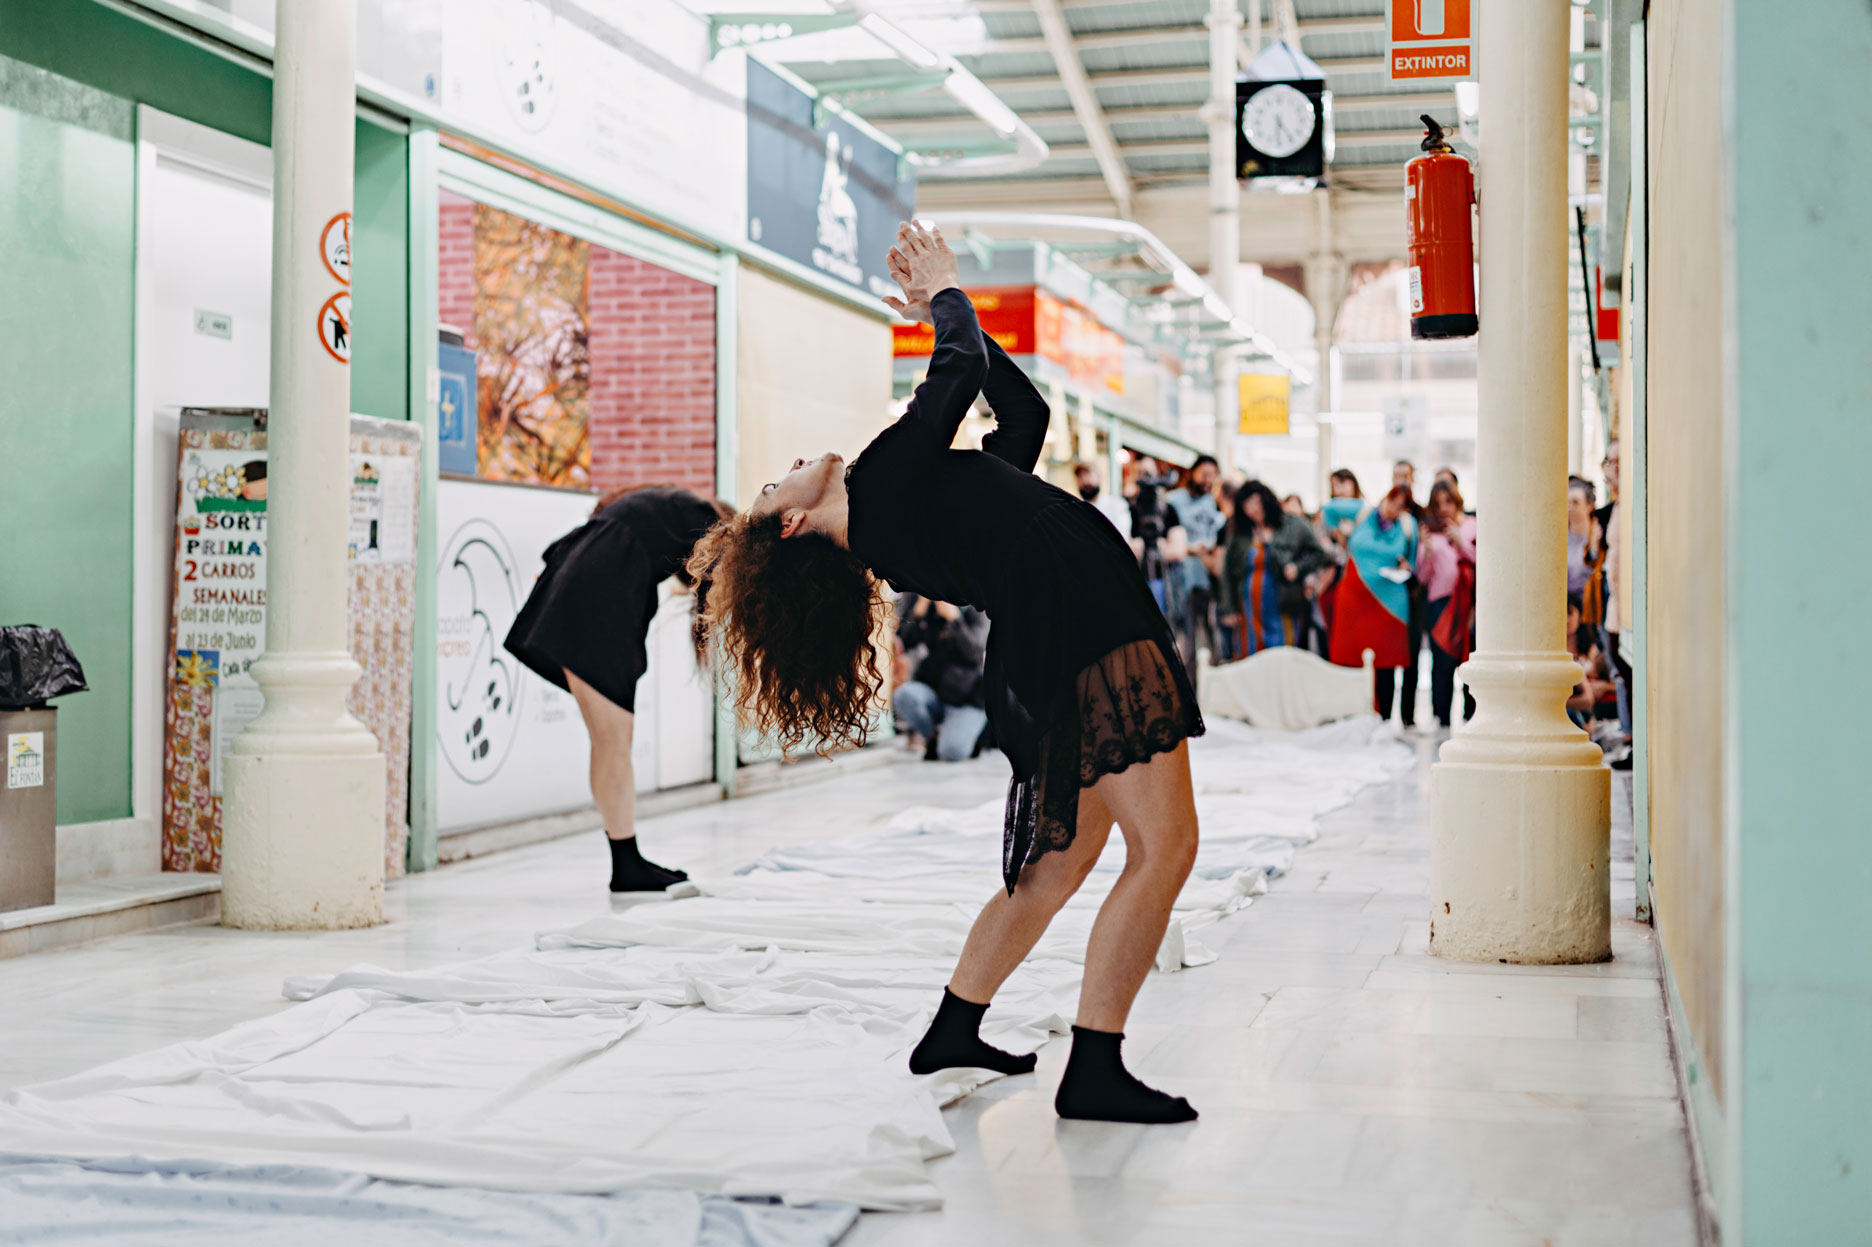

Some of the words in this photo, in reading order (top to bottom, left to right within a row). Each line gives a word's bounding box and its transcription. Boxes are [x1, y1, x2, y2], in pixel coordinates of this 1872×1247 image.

[1395, 55, 1466, 70] EXTINTOR
[187, 540, 267, 556] PRIMA
[183, 560, 198, 581] 2
[201, 561, 256, 579] CARROS
[181, 605, 197, 623] del
[211, 606, 226, 624] de
[227, 606, 263, 627] Marzo
[185, 630, 196, 650] al
[210, 631, 224, 650] de
[225, 631, 257, 652] Junio
